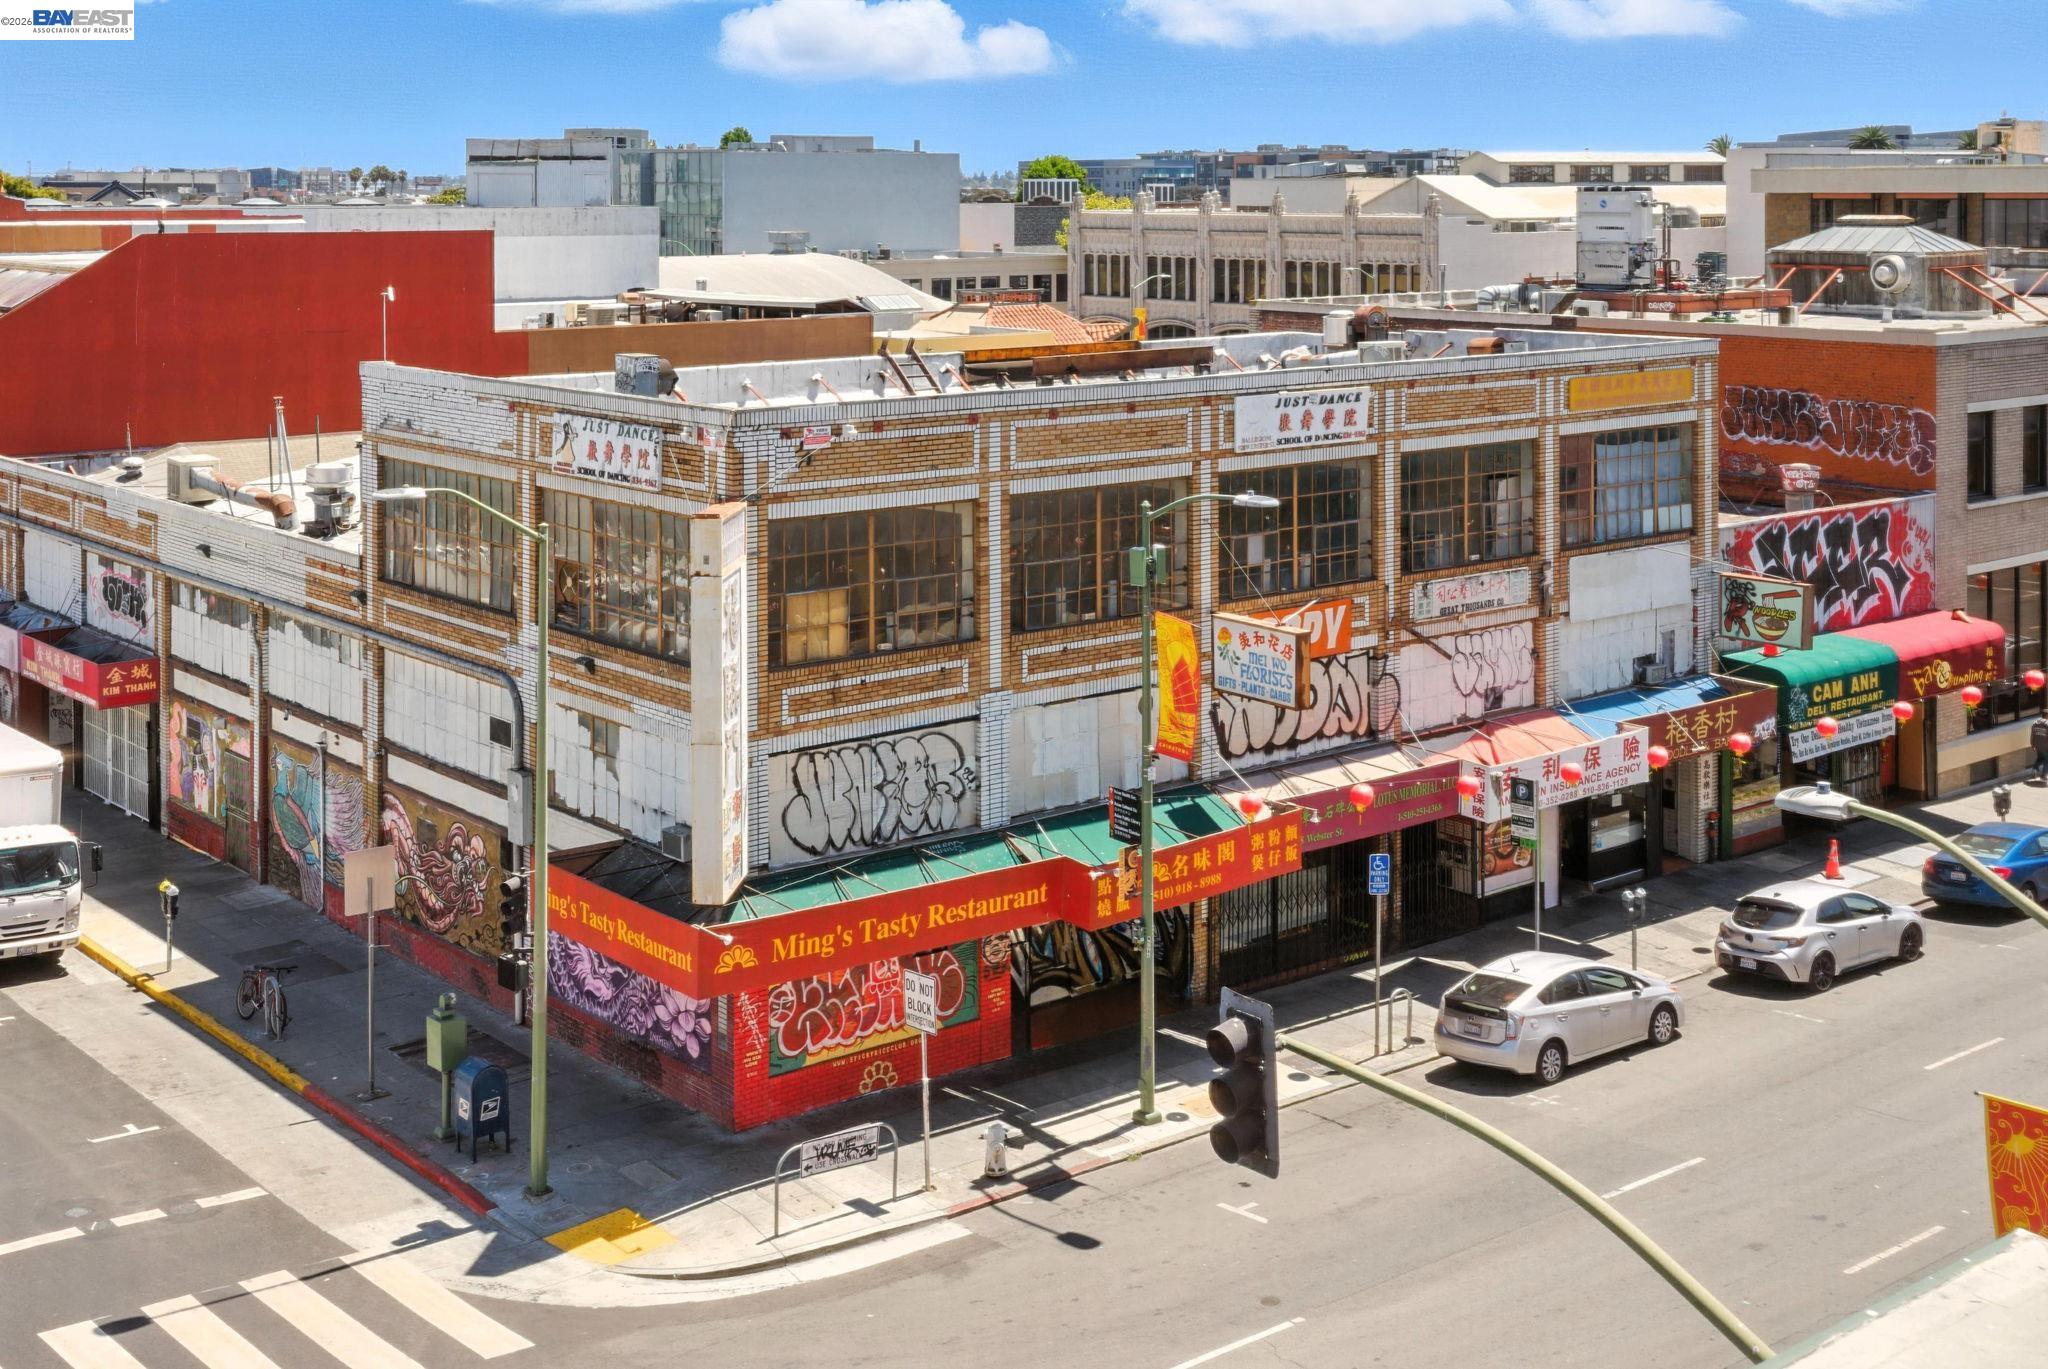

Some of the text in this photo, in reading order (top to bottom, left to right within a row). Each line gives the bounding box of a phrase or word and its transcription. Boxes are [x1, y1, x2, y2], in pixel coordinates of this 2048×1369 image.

[1275, 392, 1363, 408] JUST DANCE
[583, 420, 655, 441] JUST DANCE
[1276, 433, 1303, 445] SCHOOL
[1304, 434, 1312, 442] OF
[577, 466, 596, 477] SCHOOL
[598, 470, 605, 478] OF
[607, 472, 630, 483] DANCING
[1440, 605, 1458, 616] GREAT
[1461, 599, 1495, 612] THOUSANDS
[1754, 605, 1796, 621] NOODLES
[106, 664, 152, 684] 金城
[1272, 658, 1287, 671] WO
[1240, 664, 1293, 690] FLORISTS
[1813, 671, 1879, 702] CAM ANH
[103, 686, 120, 696] KIM
[125, 681, 157, 693] THANH
[1218, 676, 1291, 703] GIFTS PLANTS CARDS
[1807, 705, 1826, 717] DELI
[1831, 690, 1883, 712] RESTAURANT
[1666, 704, 1738, 745] 稻香村
[1605, 762, 1642, 779] AGENCY
[1373, 788, 1398, 808] LOTUS
[1154, 883, 1173, 901] 510)
[1176, 881, 1192, 896] 918
[1200, 873, 1222, 890] 8988
[548, 887, 693, 973] ing's Tasty Restaurant
[771, 882, 1048, 963] Ming's Tasty Restaurant
[905, 978, 933, 999] DO NOT
[907, 997, 932, 1016] BLOCK
[906, 1012, 935, 1029] INTERSECTION
[829, 1153, 862, 1167] CROSSWAL
